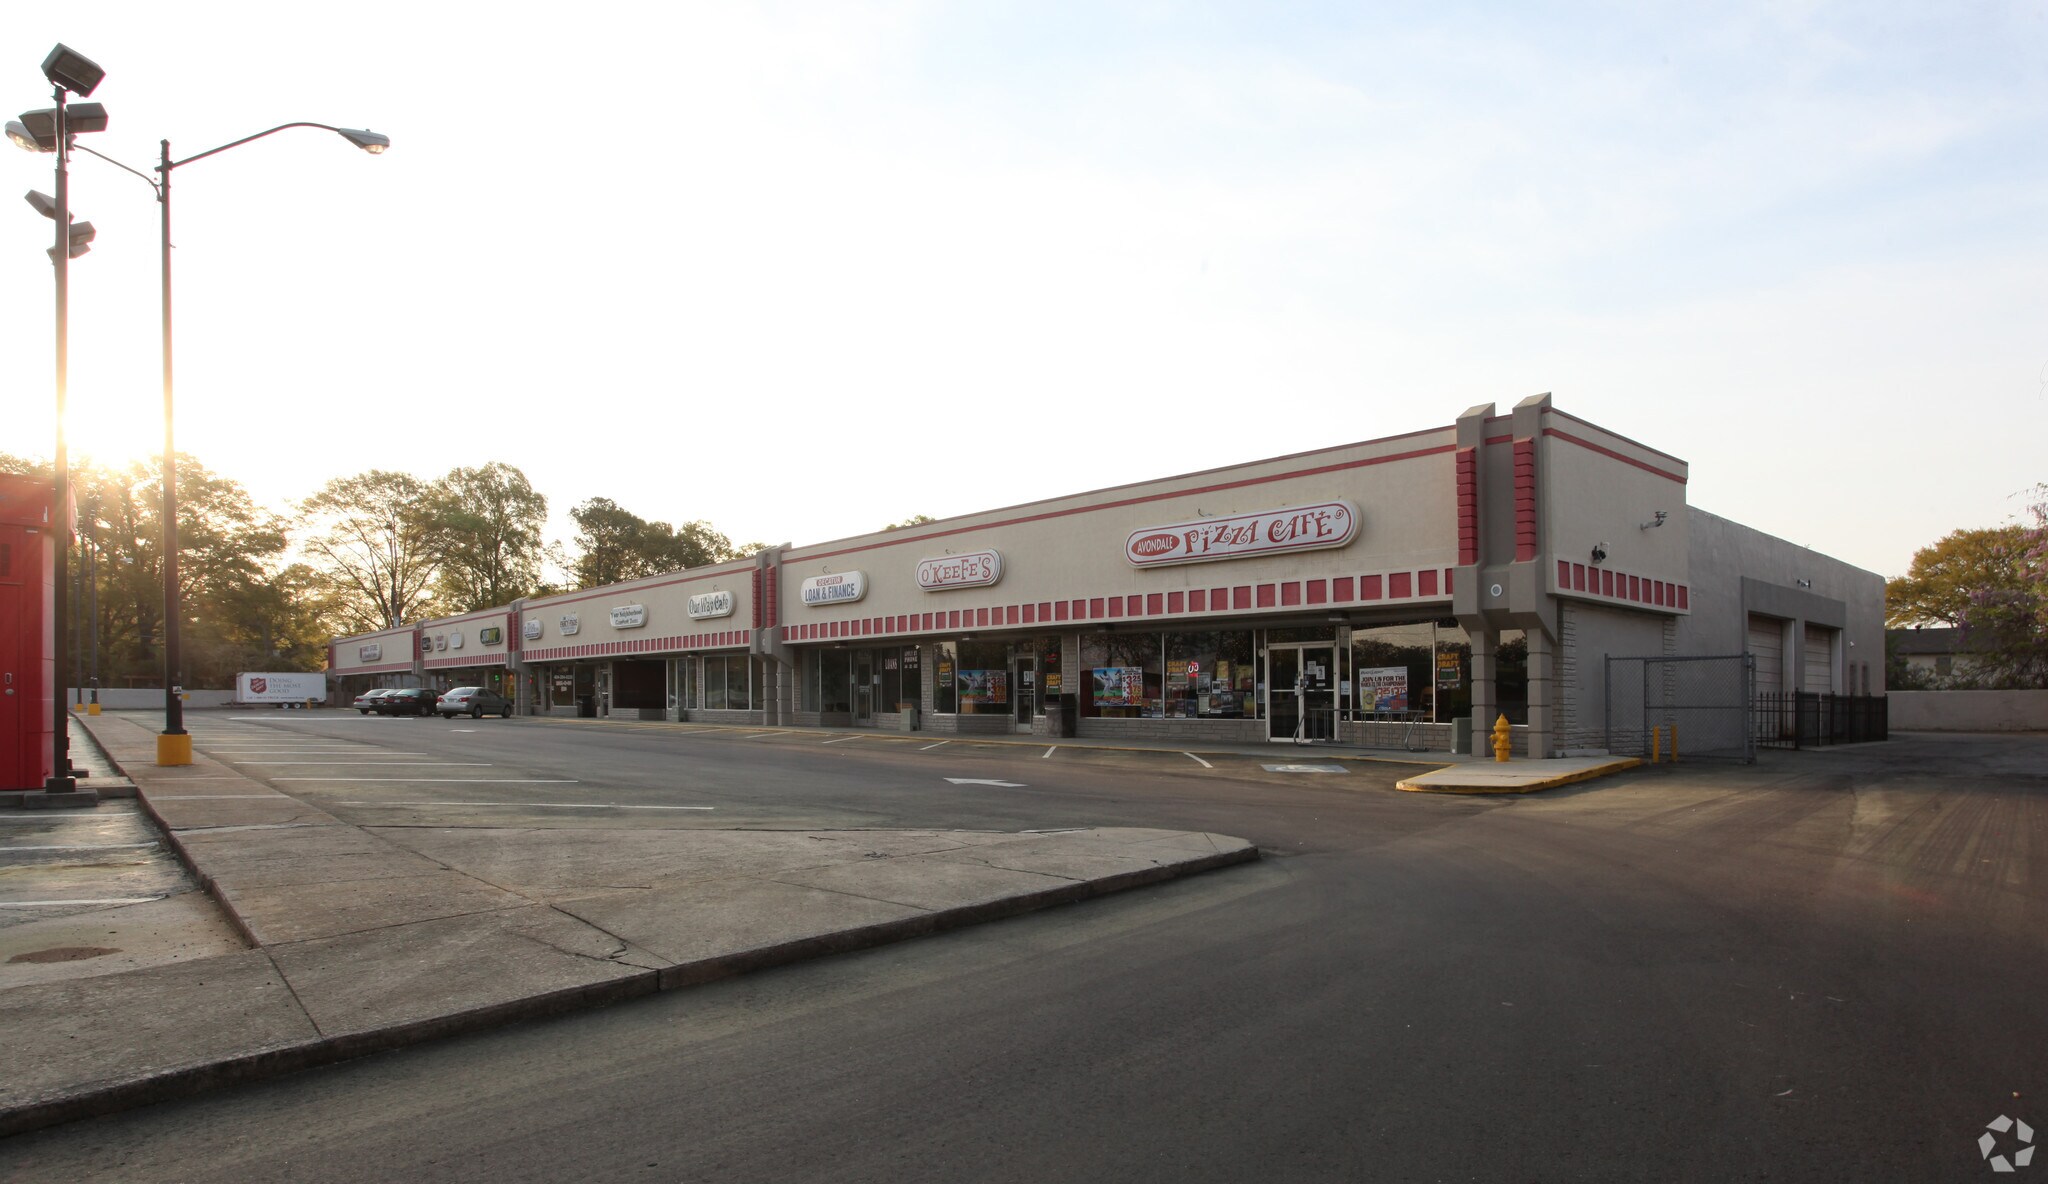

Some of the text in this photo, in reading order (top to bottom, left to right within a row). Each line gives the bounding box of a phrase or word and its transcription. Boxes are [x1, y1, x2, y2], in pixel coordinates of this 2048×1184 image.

[1136, 535, 1174, 554] AVONDALE
[921, 556, 991, 584] O'KEEFE'S
[804, 583, 855, 602] LOAN & FINANCE
